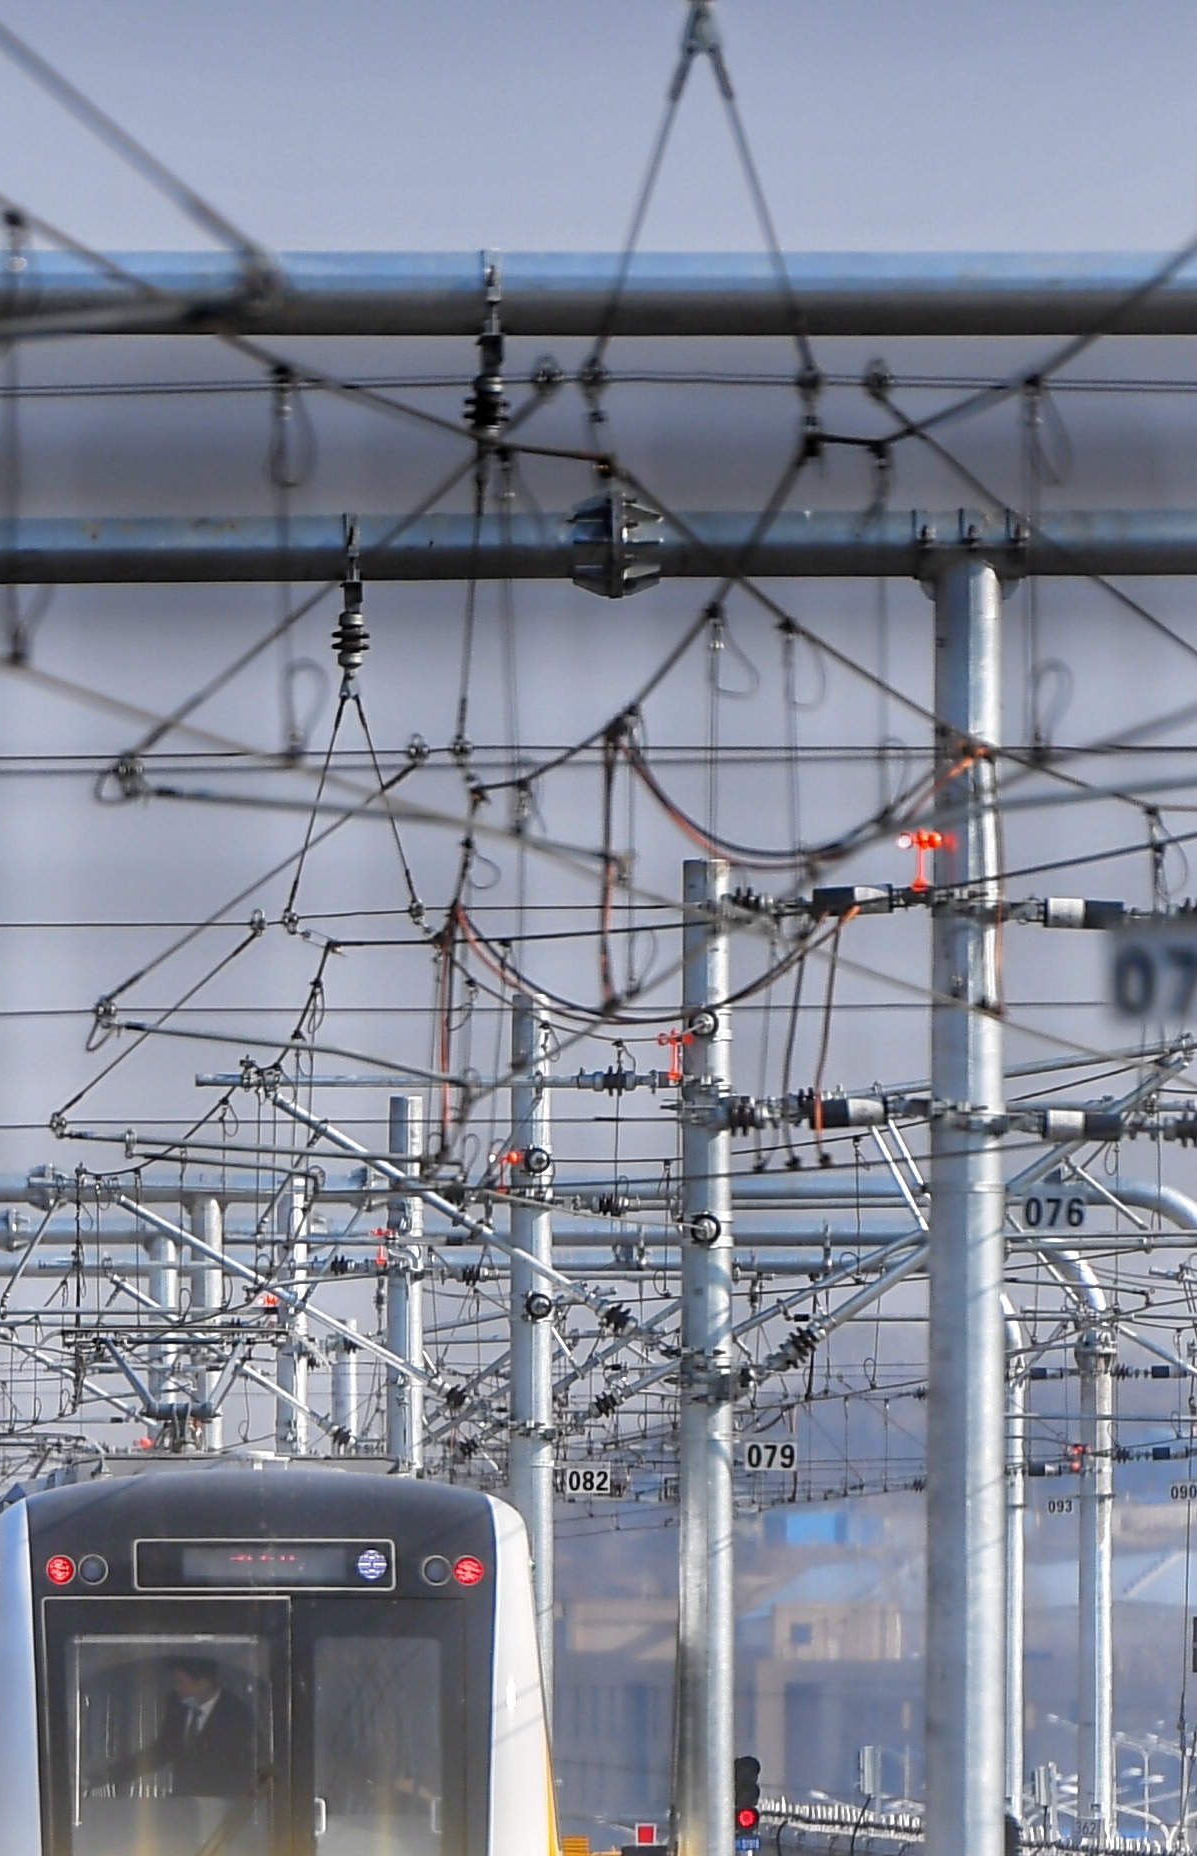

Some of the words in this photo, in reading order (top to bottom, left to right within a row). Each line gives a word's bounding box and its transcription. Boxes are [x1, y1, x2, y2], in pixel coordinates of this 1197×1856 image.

[1025, 1197, 1084, 1227] 076
[747, 1444, 795, 1469] 079
[568, 1470, 609, 1492] 082
[1170, 1485, 1197, 1500] 090
[1047, 1500, 1073, 1513] 093
[1075, 1820, 1097, 1836] 362
